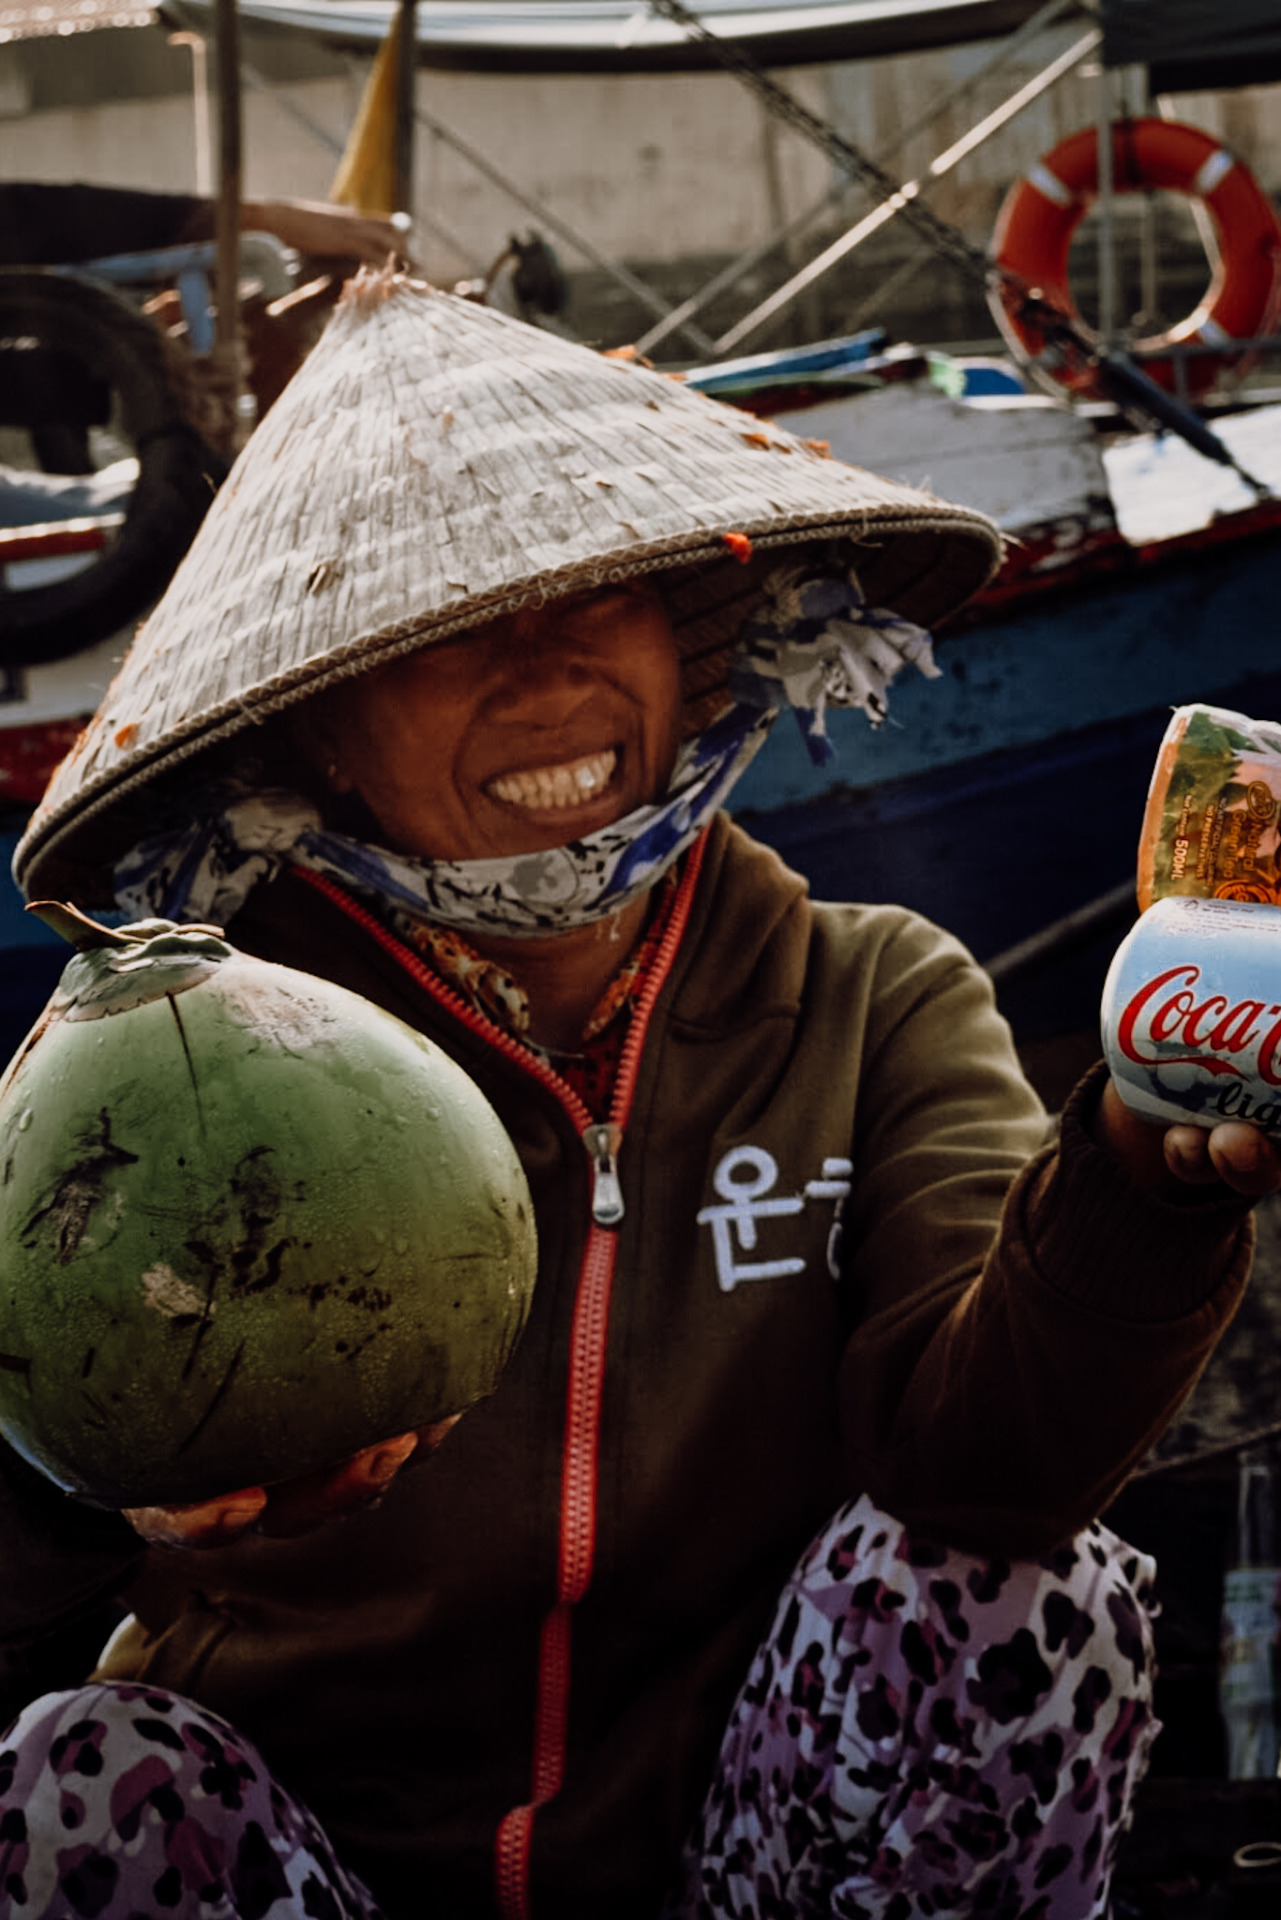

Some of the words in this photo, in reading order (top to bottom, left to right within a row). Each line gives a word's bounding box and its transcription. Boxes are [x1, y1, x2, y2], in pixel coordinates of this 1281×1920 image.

[1228, 810, 1247, 851] Green
[1243, 823, 1262, 871] Natural
[1171, 840, 1189, 880] 500ML
[1223, 854, 1238, 878] Tea
